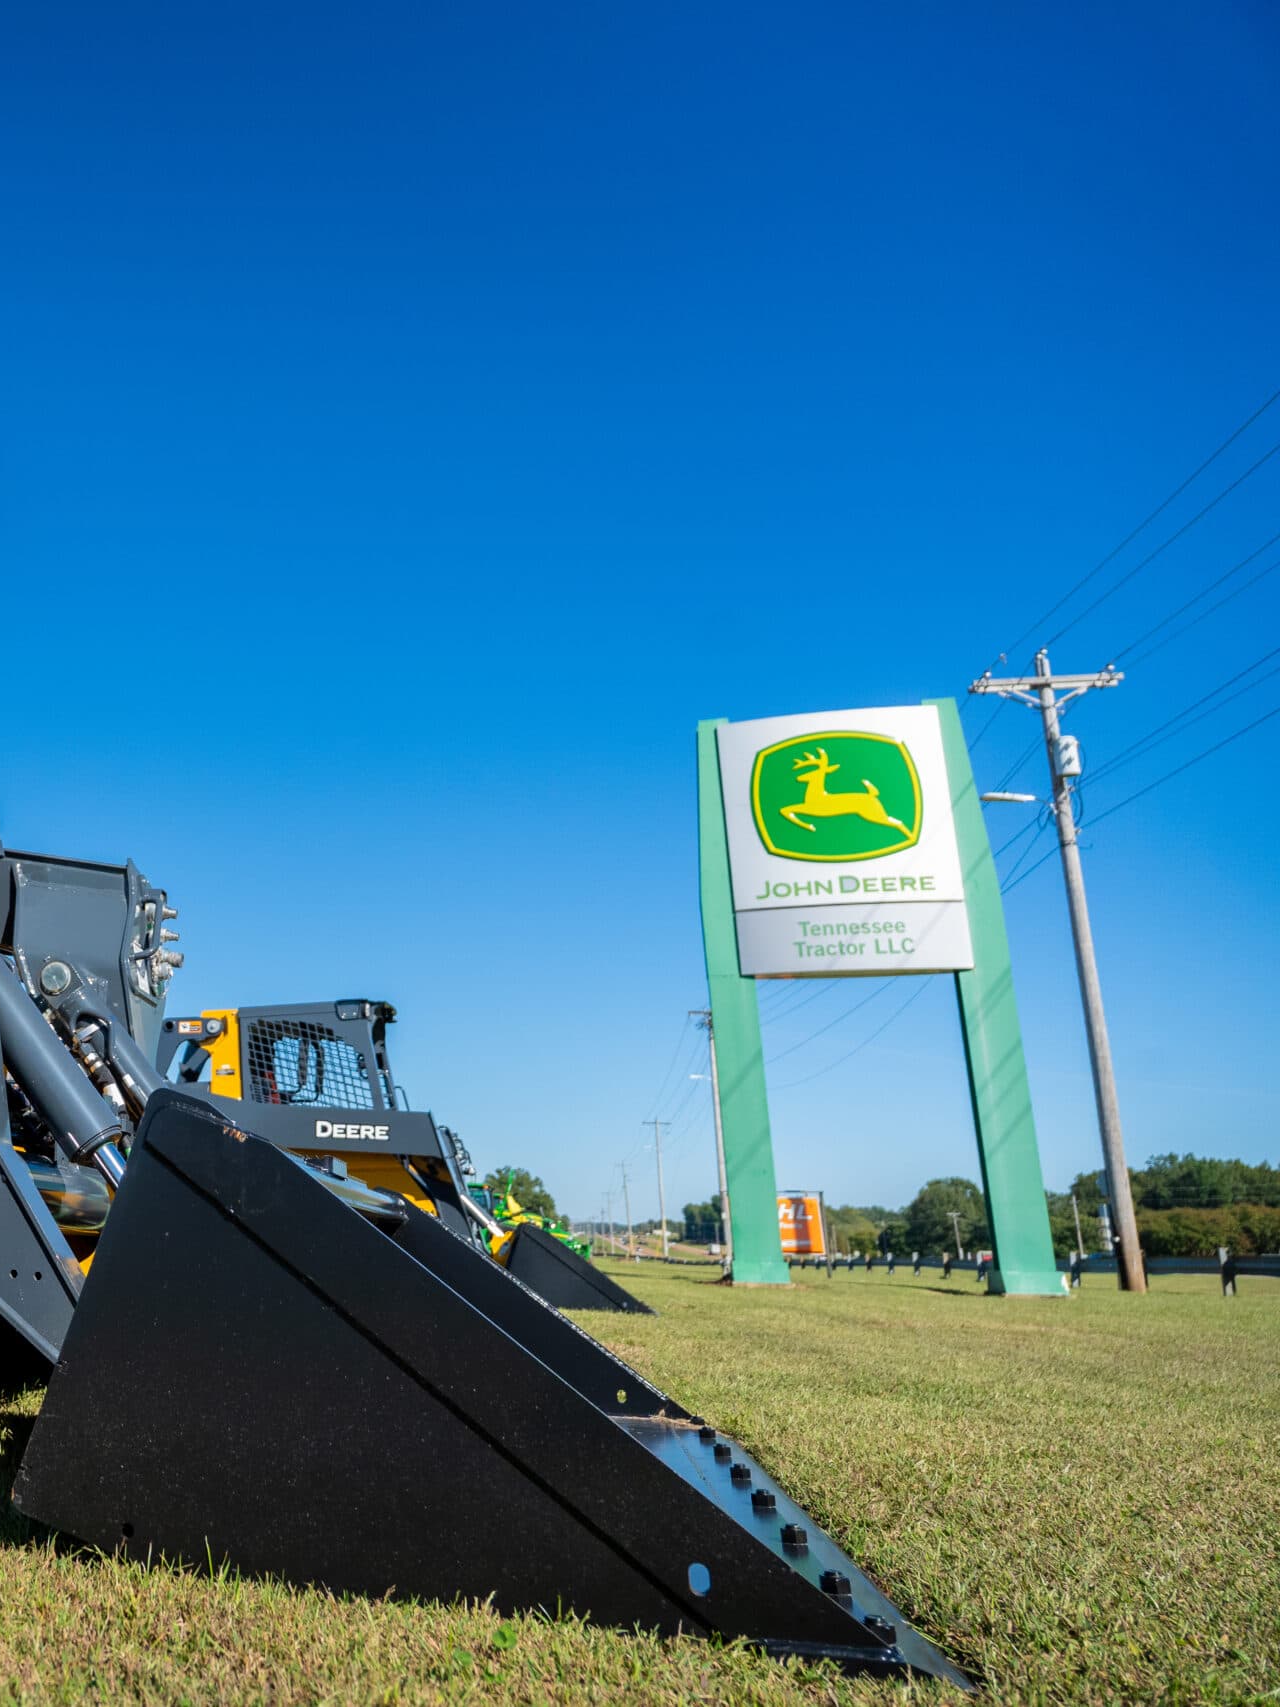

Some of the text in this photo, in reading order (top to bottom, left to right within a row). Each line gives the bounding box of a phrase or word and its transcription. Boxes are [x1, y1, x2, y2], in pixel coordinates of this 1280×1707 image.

[756, 875, 936, 900] JOHN DEERE
[798, 920, 906, 937] Tennessee
[793, 938, 915, 958] Tractor LLC
[315, 1120, 390, 1140] DEERE
